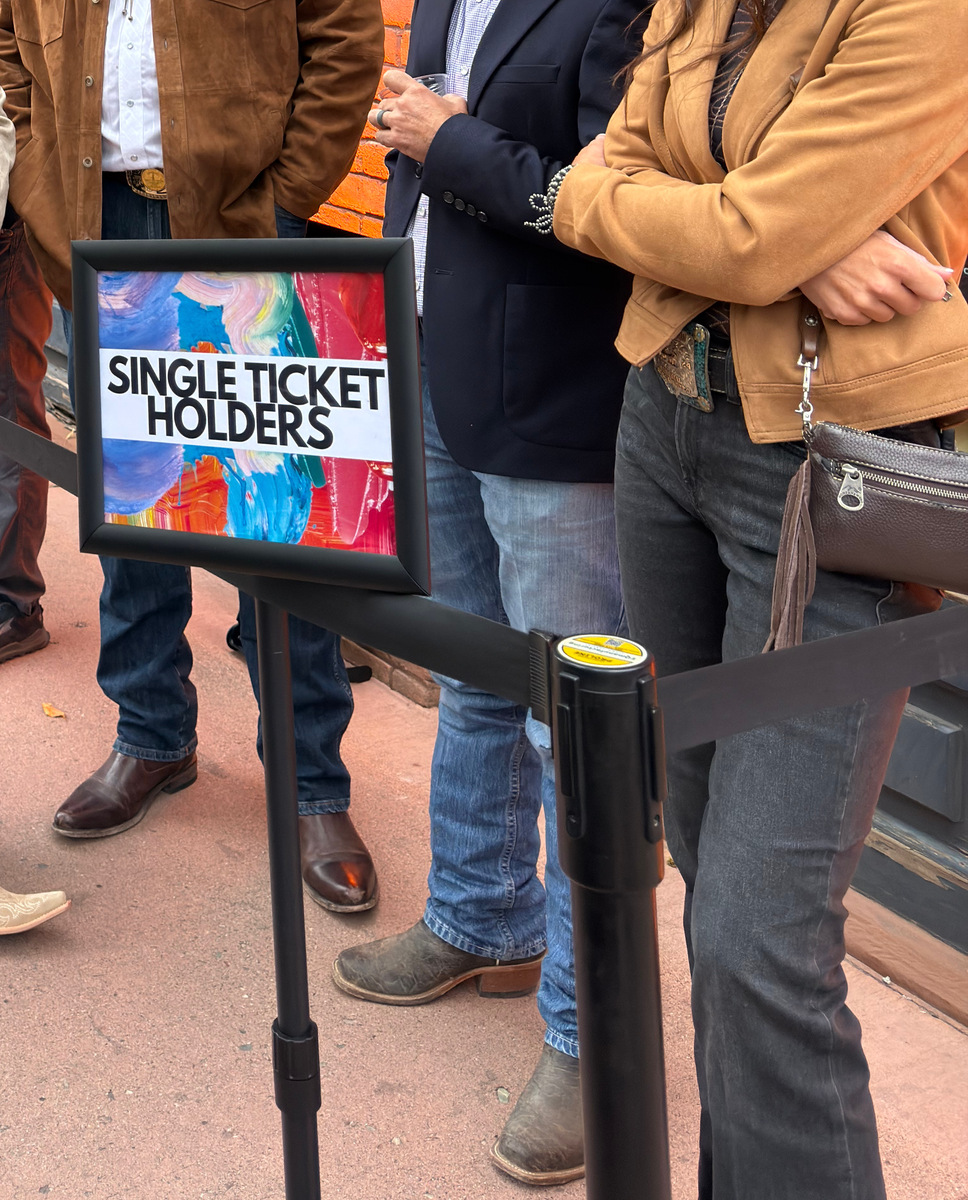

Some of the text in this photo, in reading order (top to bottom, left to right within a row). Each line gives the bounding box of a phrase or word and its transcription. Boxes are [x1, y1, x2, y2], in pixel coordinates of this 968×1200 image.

[107, 354, 386, 411] SINGLE TICKET
[147, 395, 334, 450] HOLDERS
